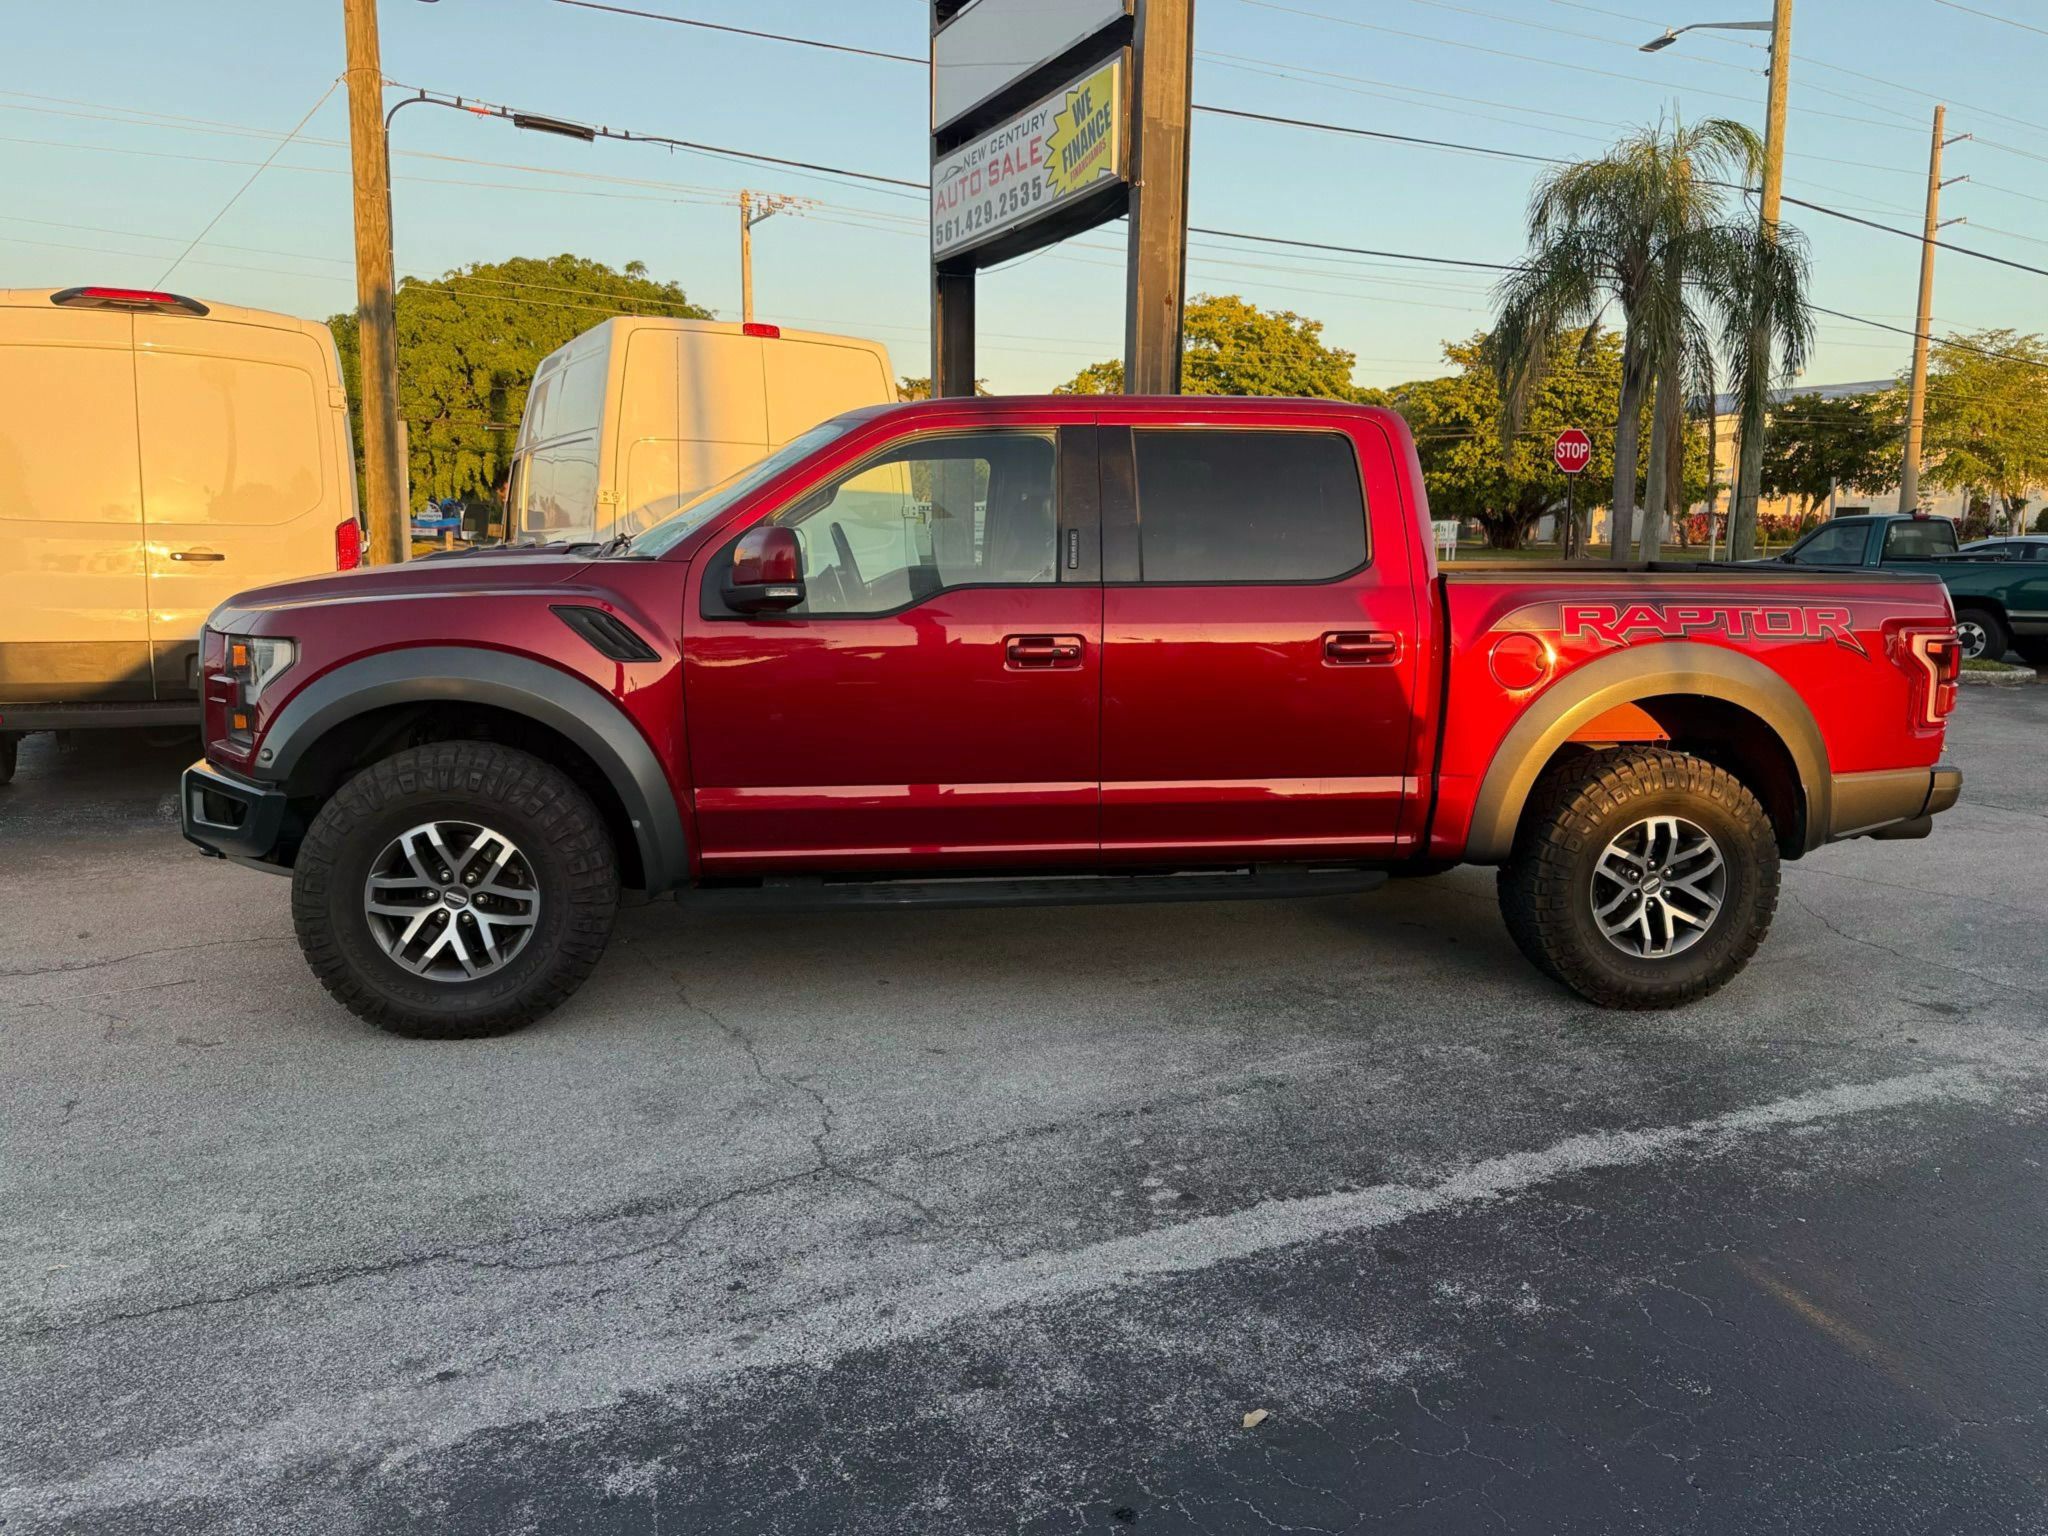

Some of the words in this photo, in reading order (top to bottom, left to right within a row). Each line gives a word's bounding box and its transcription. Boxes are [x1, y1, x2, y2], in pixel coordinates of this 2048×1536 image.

[1062, 100, 1112, 174] FINANCE
[1072, 86, 1093, 128] WE
[963, 144, 988, 170] NEW
[990, 110, 1049, 154] CENTURY
[935, 169, 982, 216] AUTO
[988, 135, 1043, 187] SALE
[936, 175, 1042, 246] 561.429.2535
[1557, 442, 1588, 459] STOP
[1560, 604, 1872, 662] RAPTOR
